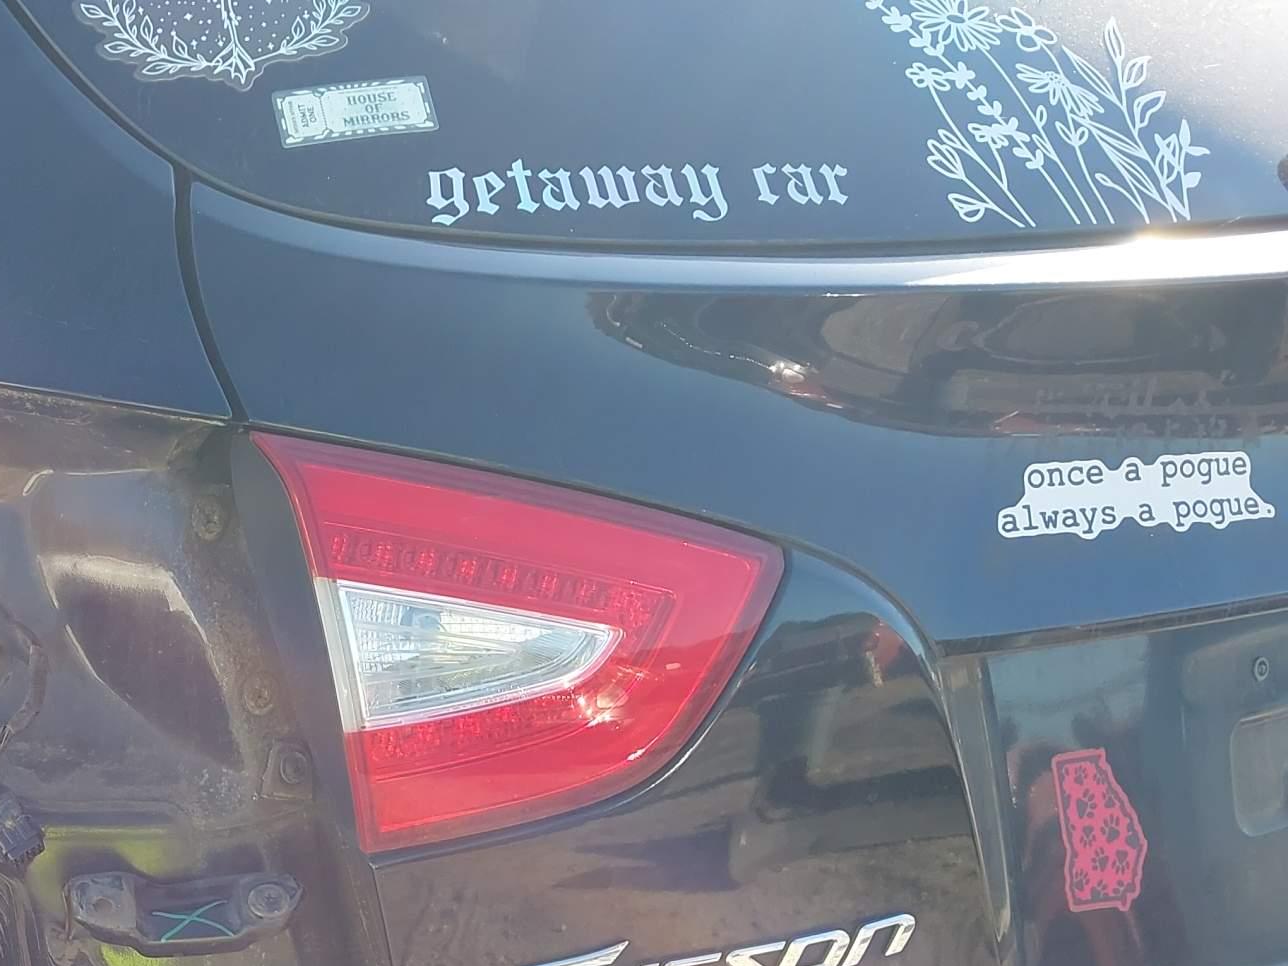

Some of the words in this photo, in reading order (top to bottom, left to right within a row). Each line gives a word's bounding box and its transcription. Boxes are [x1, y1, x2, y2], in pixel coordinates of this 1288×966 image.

[346, 91, 397, 106] HOUSE
[364, 103, 383, 114] OF
[297, 103, 310, 128] ADMIT
[306, 106, 318, 123] ONE
[342, 111, 411, 127] MIRRORS
[426, 158, 728, 226] getaway
[751, 162, 849, 206] car
[1027, 464, 1104, 488] once
[1124, 462, 1142, 482] a
[1160, 456, 1247, 487] pogue
[1001, 504, 1117, 534] always
[1138, 503, 1155, 522] a
[1172, 496, 1273, 527] pogue.
